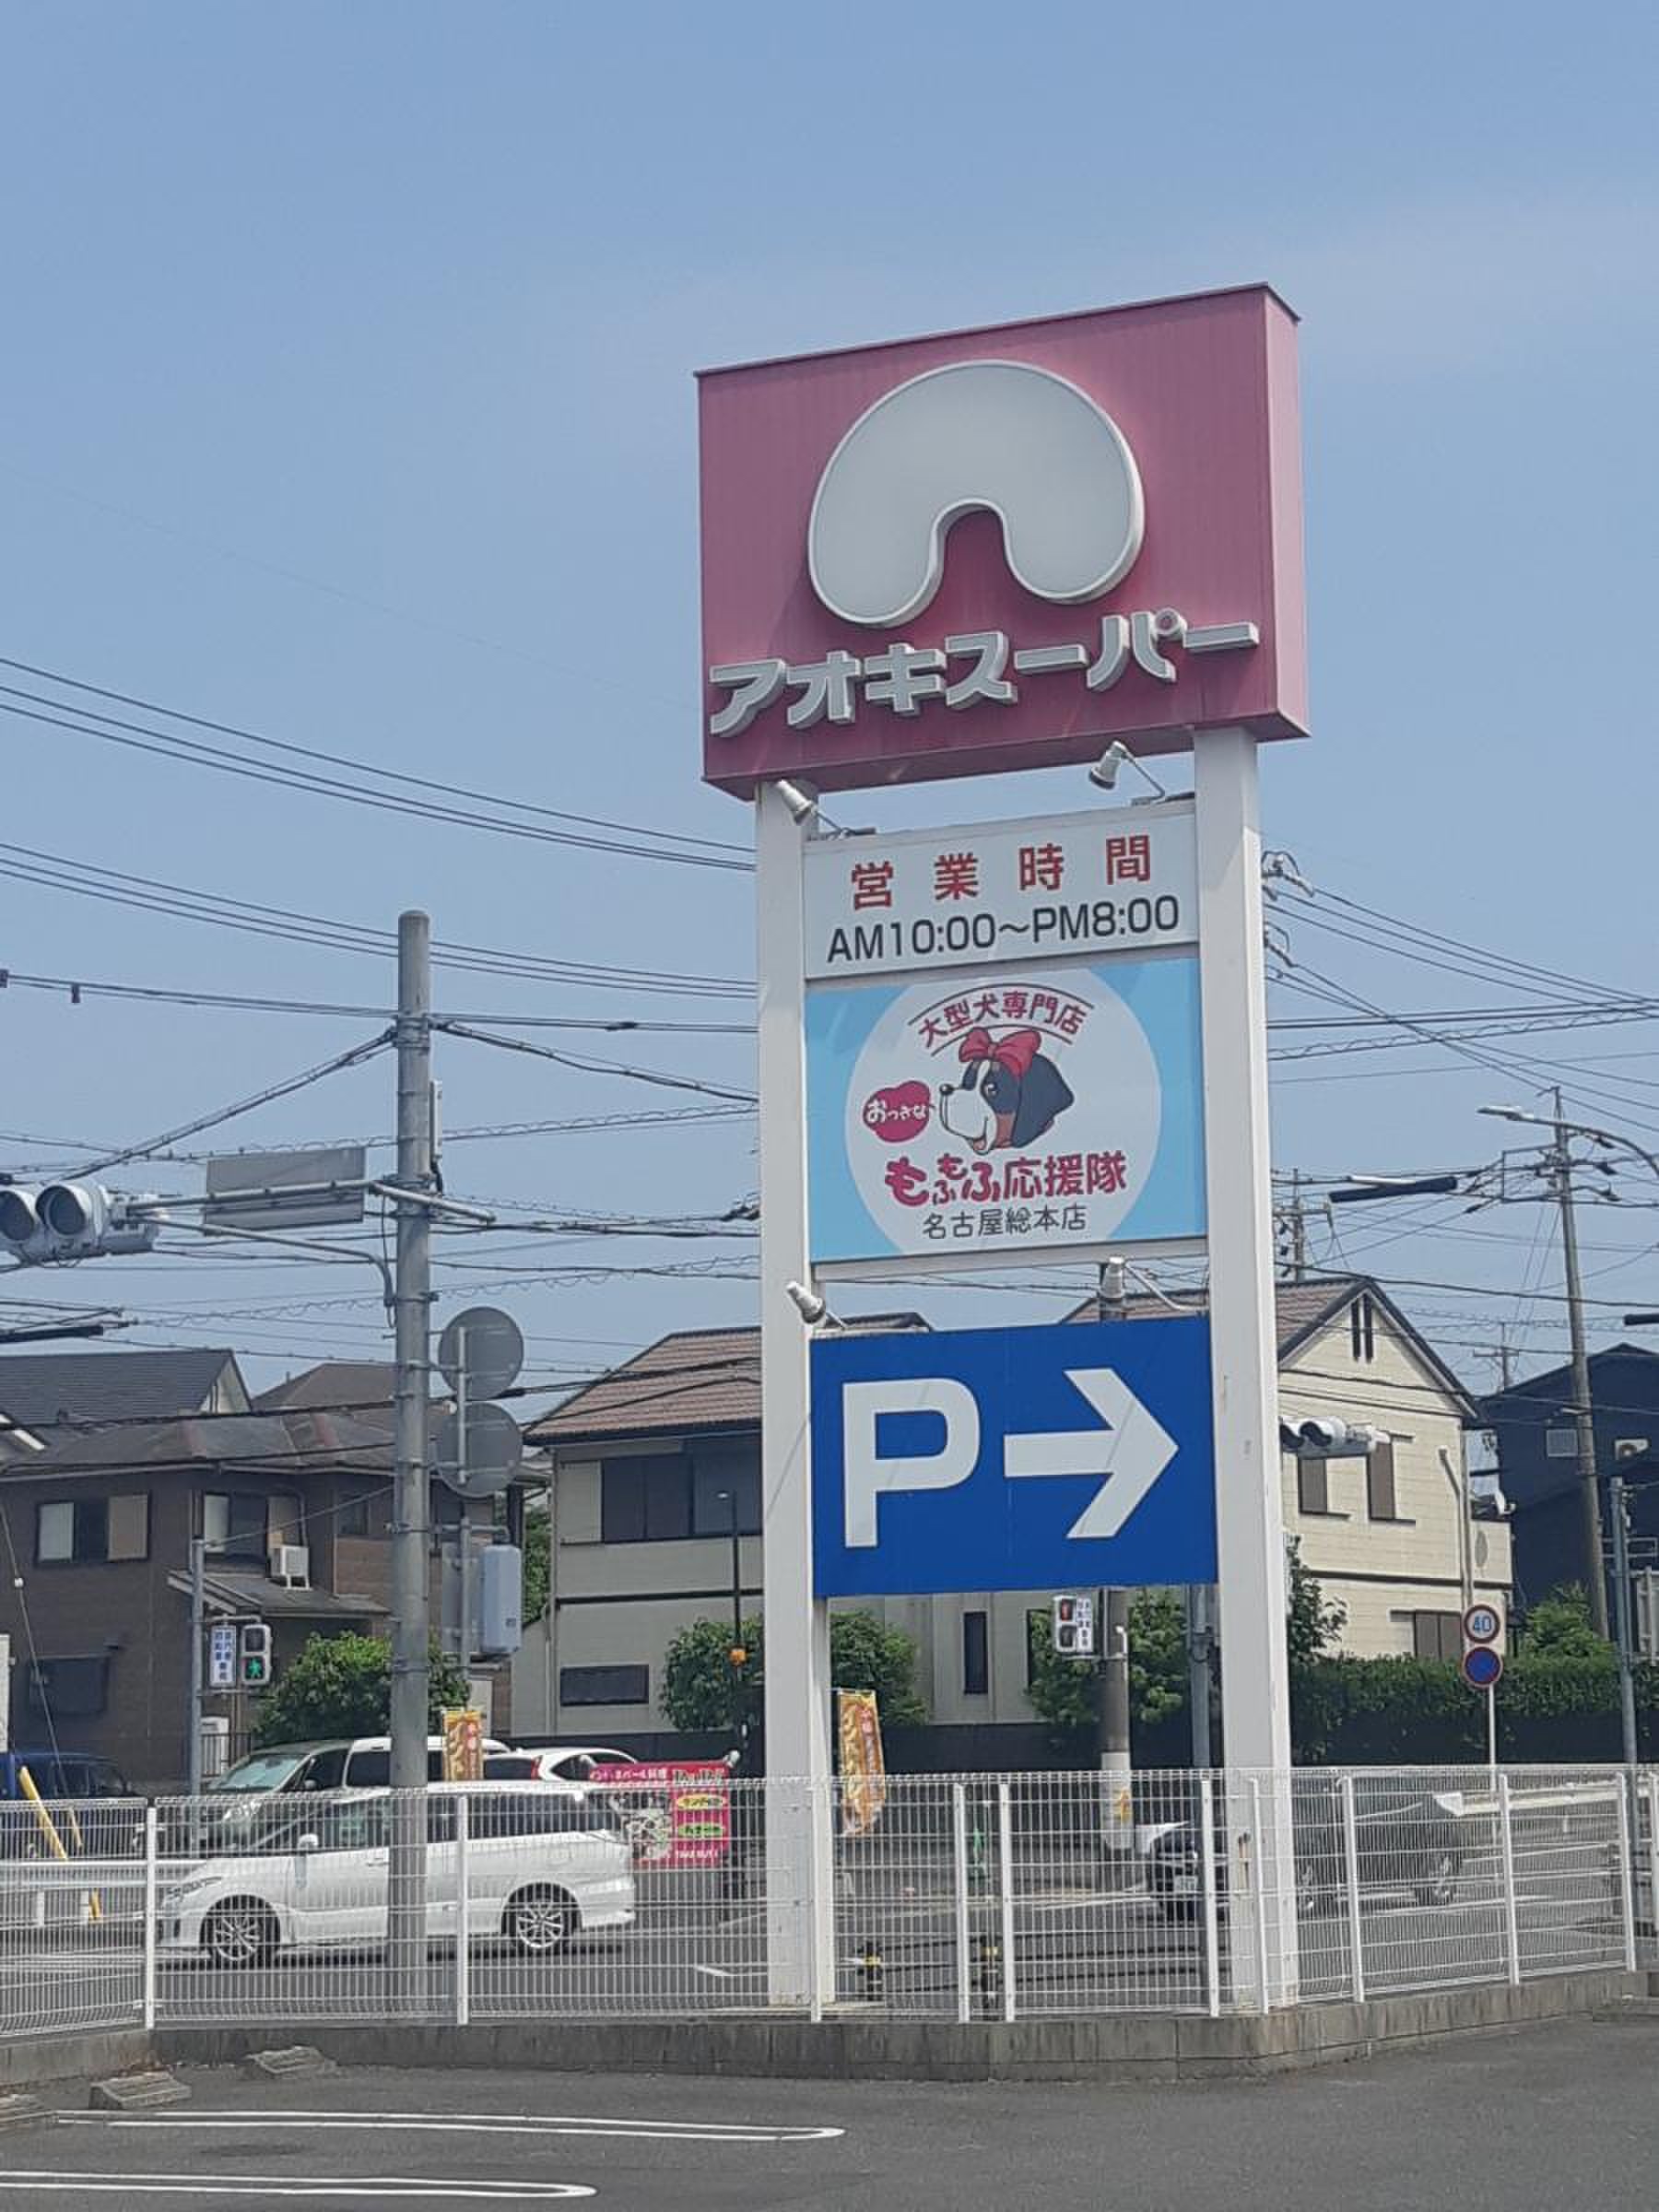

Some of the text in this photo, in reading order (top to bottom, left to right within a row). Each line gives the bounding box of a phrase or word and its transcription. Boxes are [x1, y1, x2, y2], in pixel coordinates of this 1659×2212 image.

[710, 608, 1259, 735] アオキスーパー
[851, 834, 1151, 911] 営業時間
[918, 991, 1087, 1049] 大型犬専門店
[923, 1203, 1088, 1240] 名古屋総本店
[841, 1377, 981, 1548] P
[1473, 1615, 1491, 1632] 40
